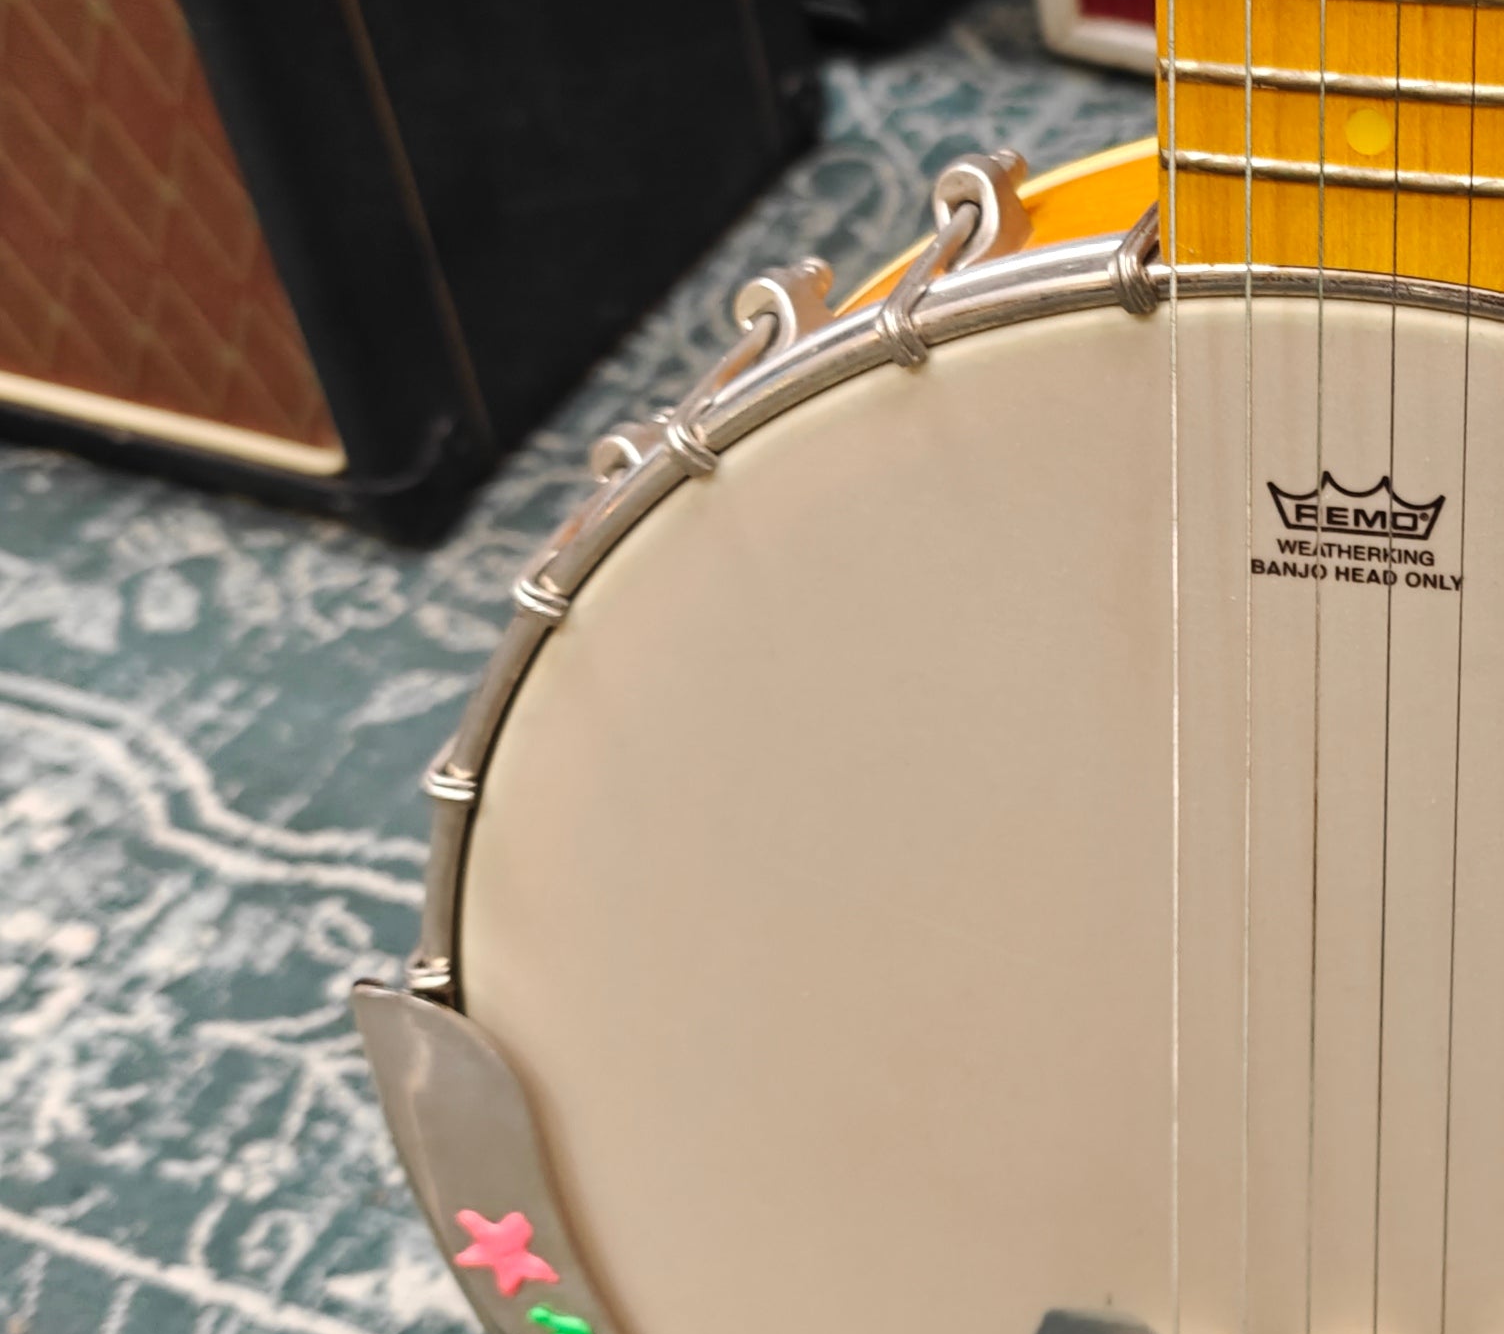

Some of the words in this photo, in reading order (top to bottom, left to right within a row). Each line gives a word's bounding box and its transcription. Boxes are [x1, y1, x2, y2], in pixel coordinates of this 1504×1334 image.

[1295, 504, 1418, 531] REMO
[1276, 538, 1435, 566] WEATHERKING
[1250, 558, 1327, 580] BANJO
[1335, 566, 1397, 586] HEAD
[1405, 572, 1463, 591] ONLY
